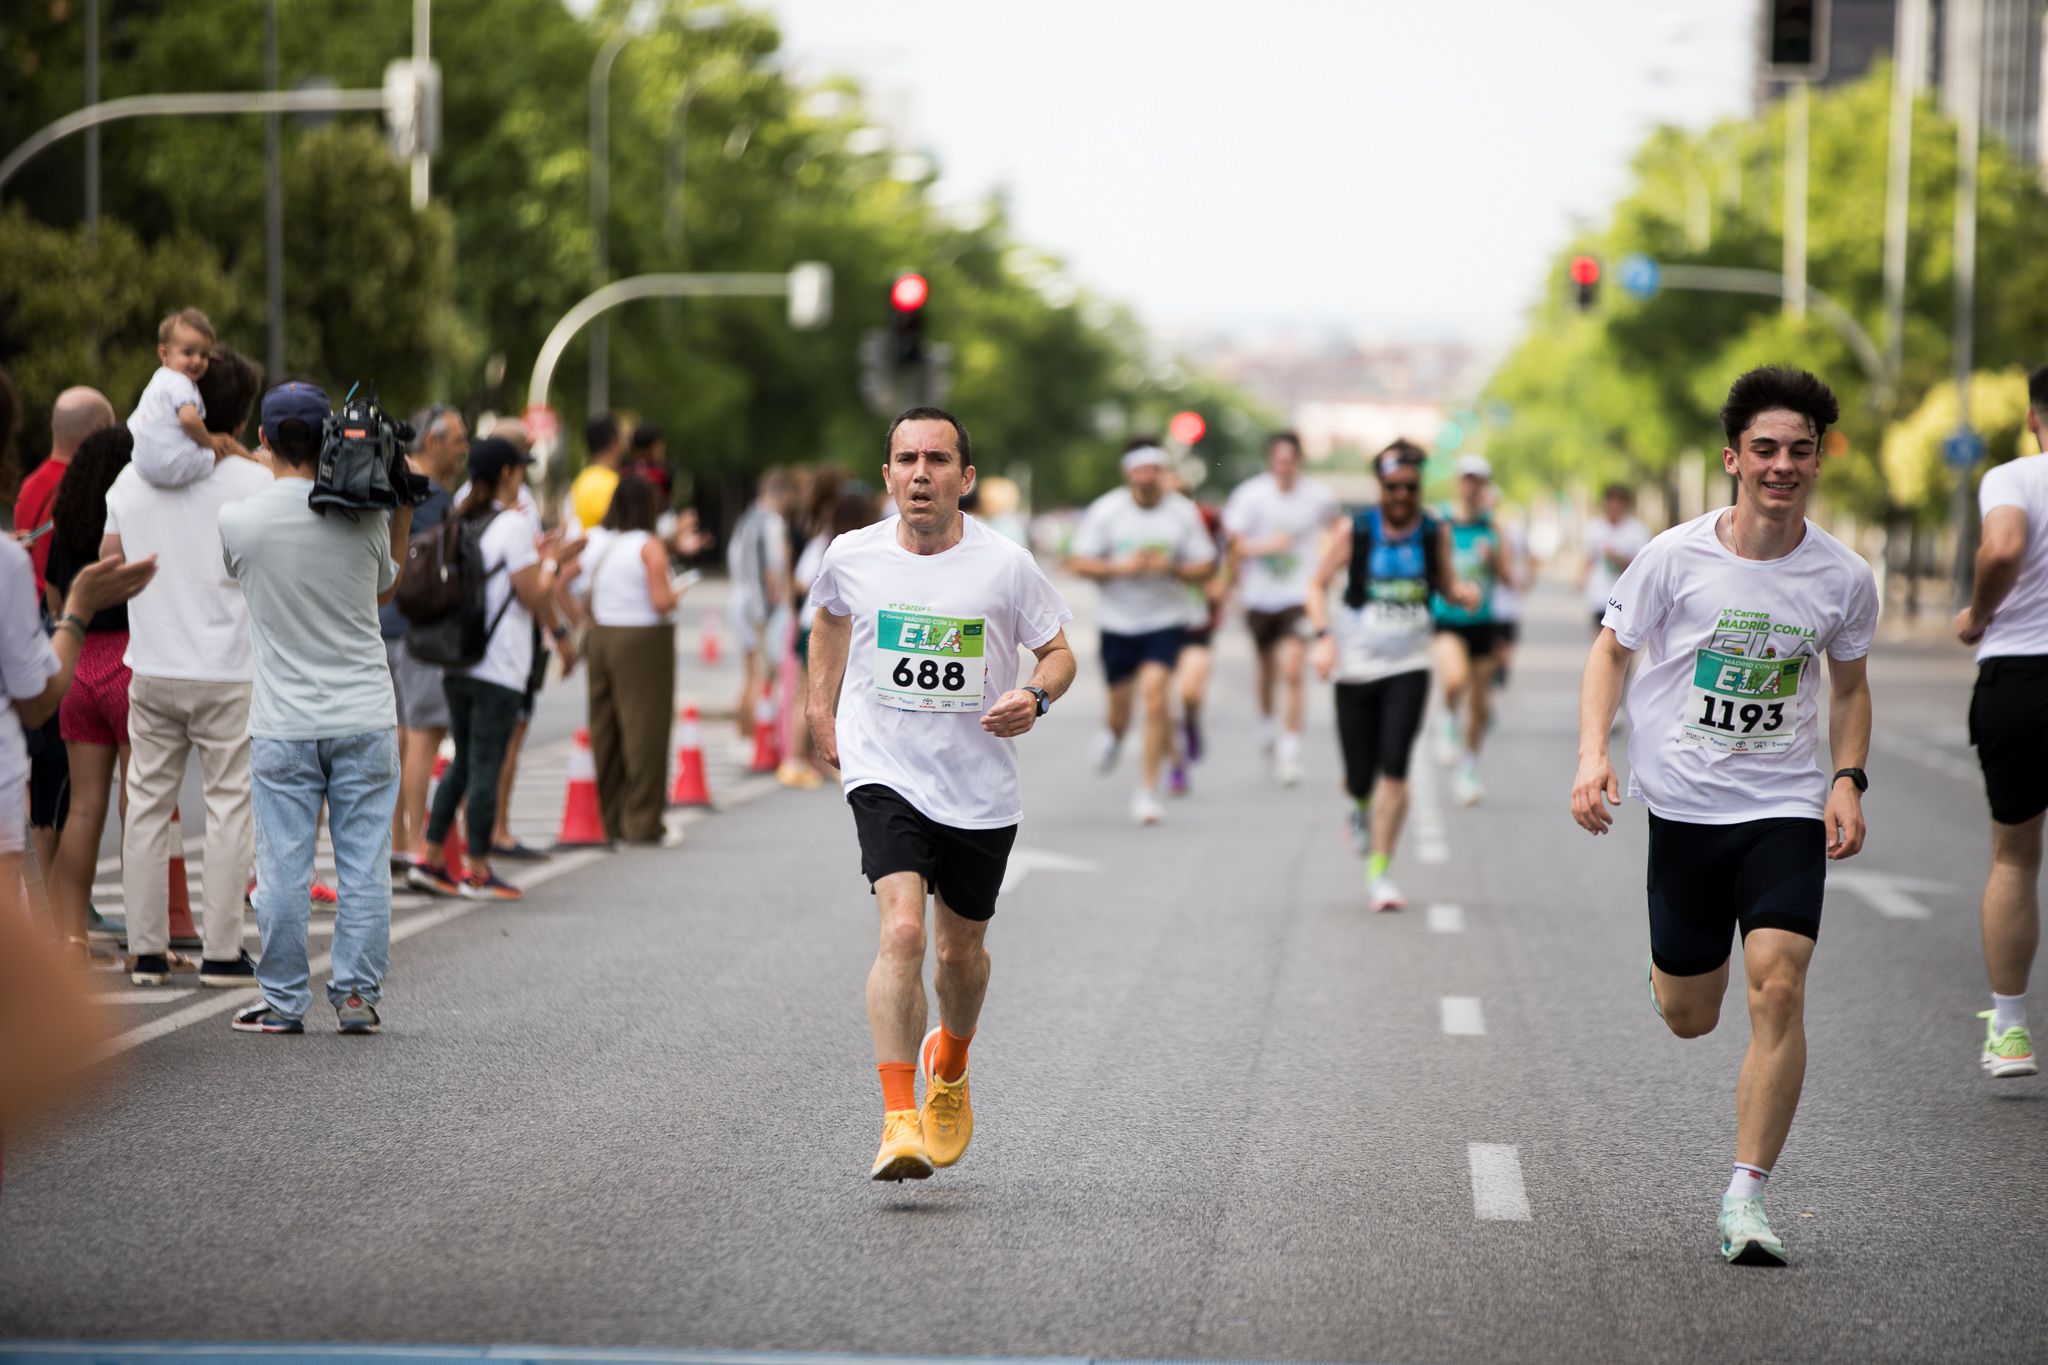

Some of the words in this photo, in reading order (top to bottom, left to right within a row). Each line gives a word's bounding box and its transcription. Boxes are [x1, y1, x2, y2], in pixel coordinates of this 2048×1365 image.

[904, 616, 931, 624] MADRID
[1734, 609, 1770, 619] Carrera
[898, 622, 961, 653] ELA
[1717, 619, 1770, 631] MADRID
[1773, 624, 1801, 636] CON
[1803, 628, 1816, 638] LA
[893, 657, 965, 691] 688
[1724, 658, 1753, 668] MADRID
[1714, 665, 1780, 695] ELA
[1699, 695, 1785, 733] 1193
